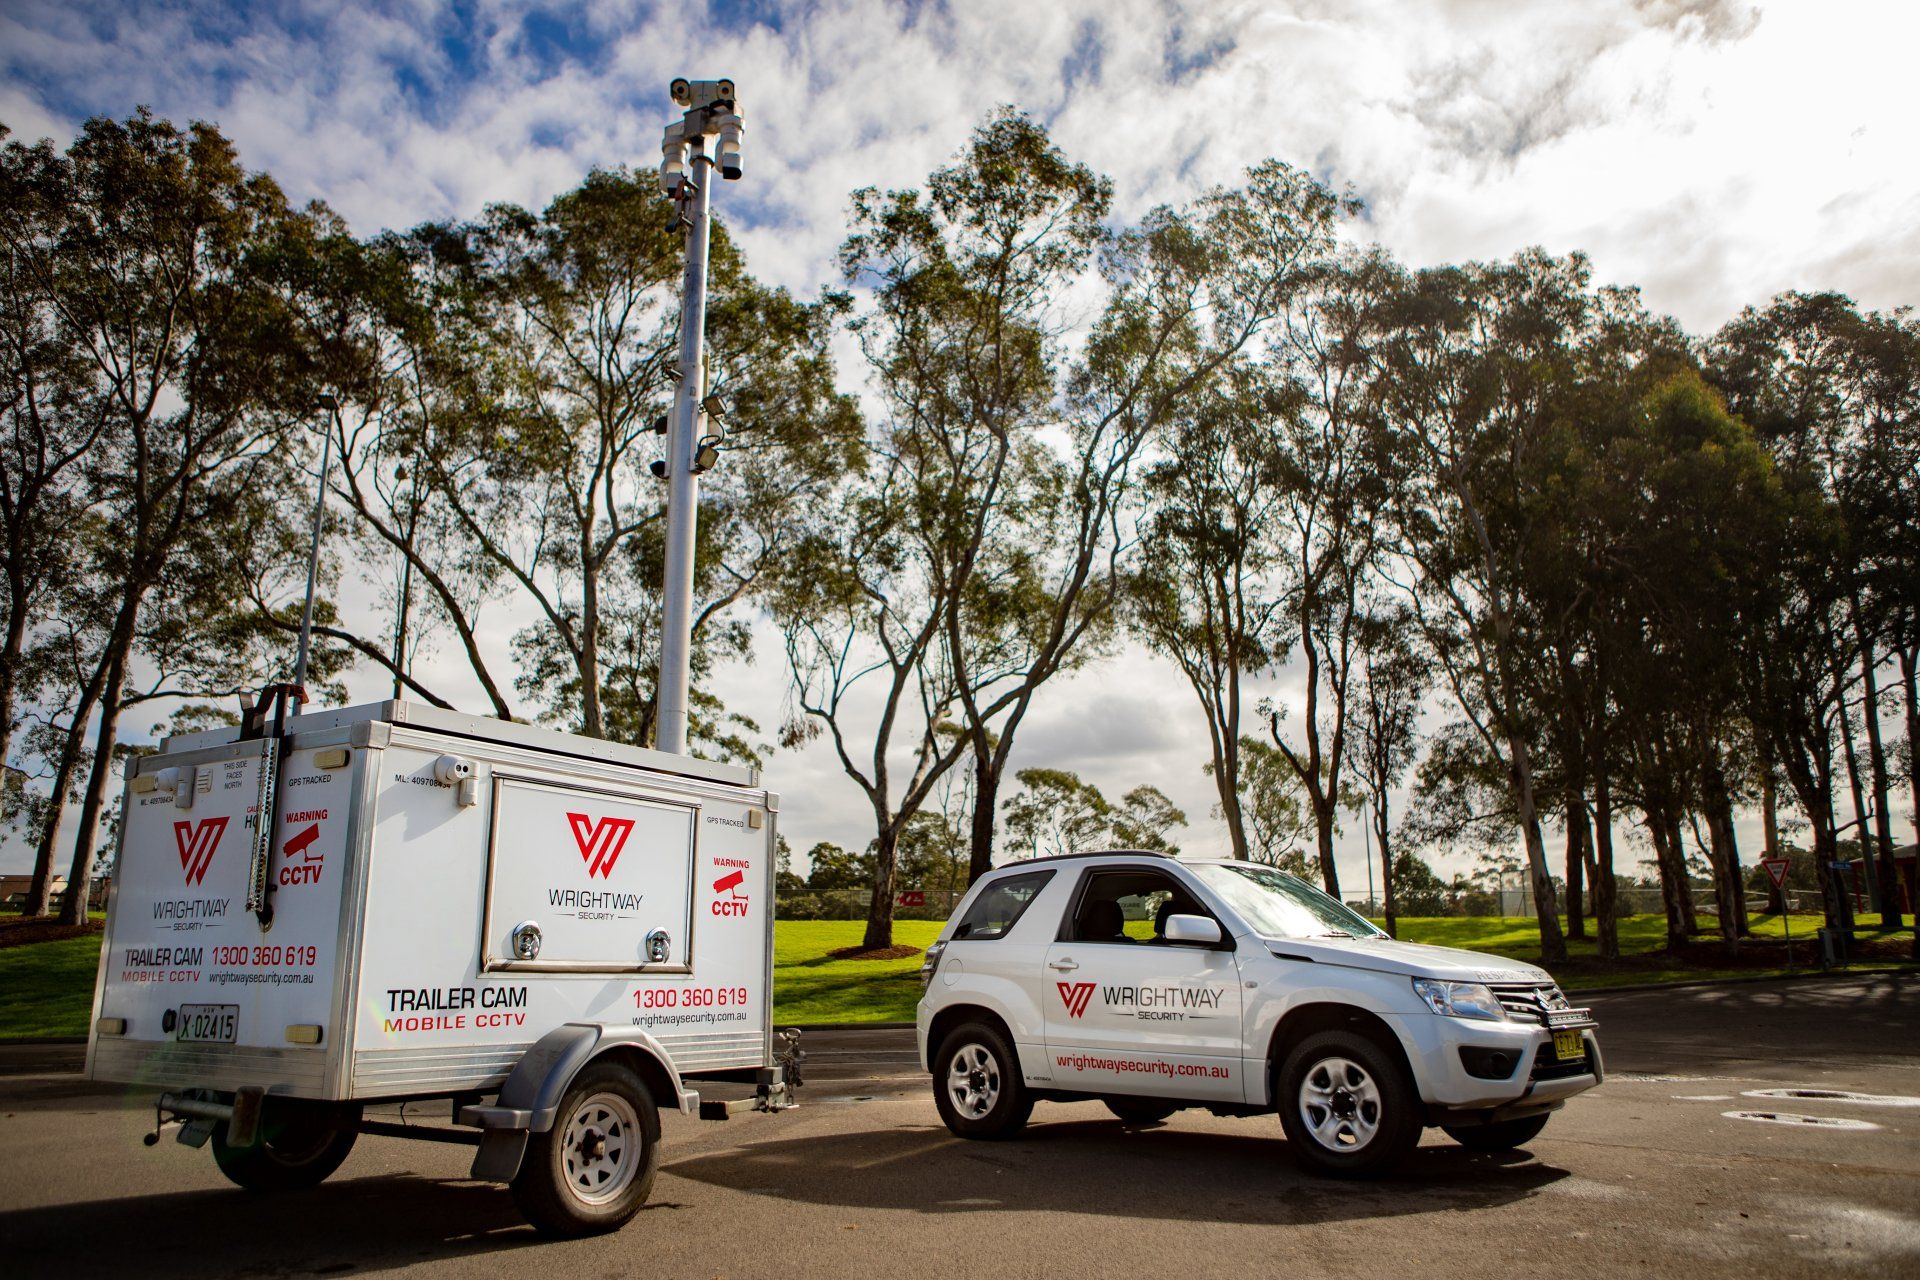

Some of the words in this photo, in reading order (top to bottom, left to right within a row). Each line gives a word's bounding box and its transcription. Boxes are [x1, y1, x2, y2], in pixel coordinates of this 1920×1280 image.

[236, 760, 248, 768] SIDE
[226, 771, 242, 779] FACES
[288, 777, 301, 787] GPS
[302, 774, 332, 785] TRACKED
[394, 774, 410, 784] ML:
[224, 781, 242, 790] NORTH
[286, 809, 328, 823] WARNING
[706, 816, 719, 825] GPS
[719, 818, 744, 828] TRACKED
[713, 857, 750, 869] WARNING
[279, 865, 323, 886] CCTV
[548, 888, 643, 911] WRIGHTWAY
[153, 898, 231, 919] WRIGHTWAY
[577, 911, 615, 921] SECURITY
[711, 900, 748, 917] CCTV
[172, 922, 204, 931] SECURITY
[125, 948, 172, 967] TRAILER
[173, 946, 203, 966] CAM
[212, 946, 249, 965] 1300
[251, 946, 282, 966] 360
[285, 945, 316, 966] 619
[121, 970, 165, 983] MOBILE
[169, 970, 201, 982] CCTV
[208, 970, 314, 986] wrightwaysecurity.com.au
[387, 988, 476, 1012] TRAILER
[481, 986, 528, 1008] CAM
[632, 989, 678, 1009] 1300
[682, 988, 713, 1007] 360
[718, 987, 747, 1006] 619
[1103, 986, 1224, 1009] WRIGHTWAY
[384, 1015, 466, 1033] MOBILE
[475, 1013, 526, 1028] CCTV
[632, 1011, 747, 1028] wrightwaysecurity.com.au
[1137, 1011, 1185, 1021] SECURITY
[1056, 1053, 1229, 1079] wrightwaysecurity.com.au
